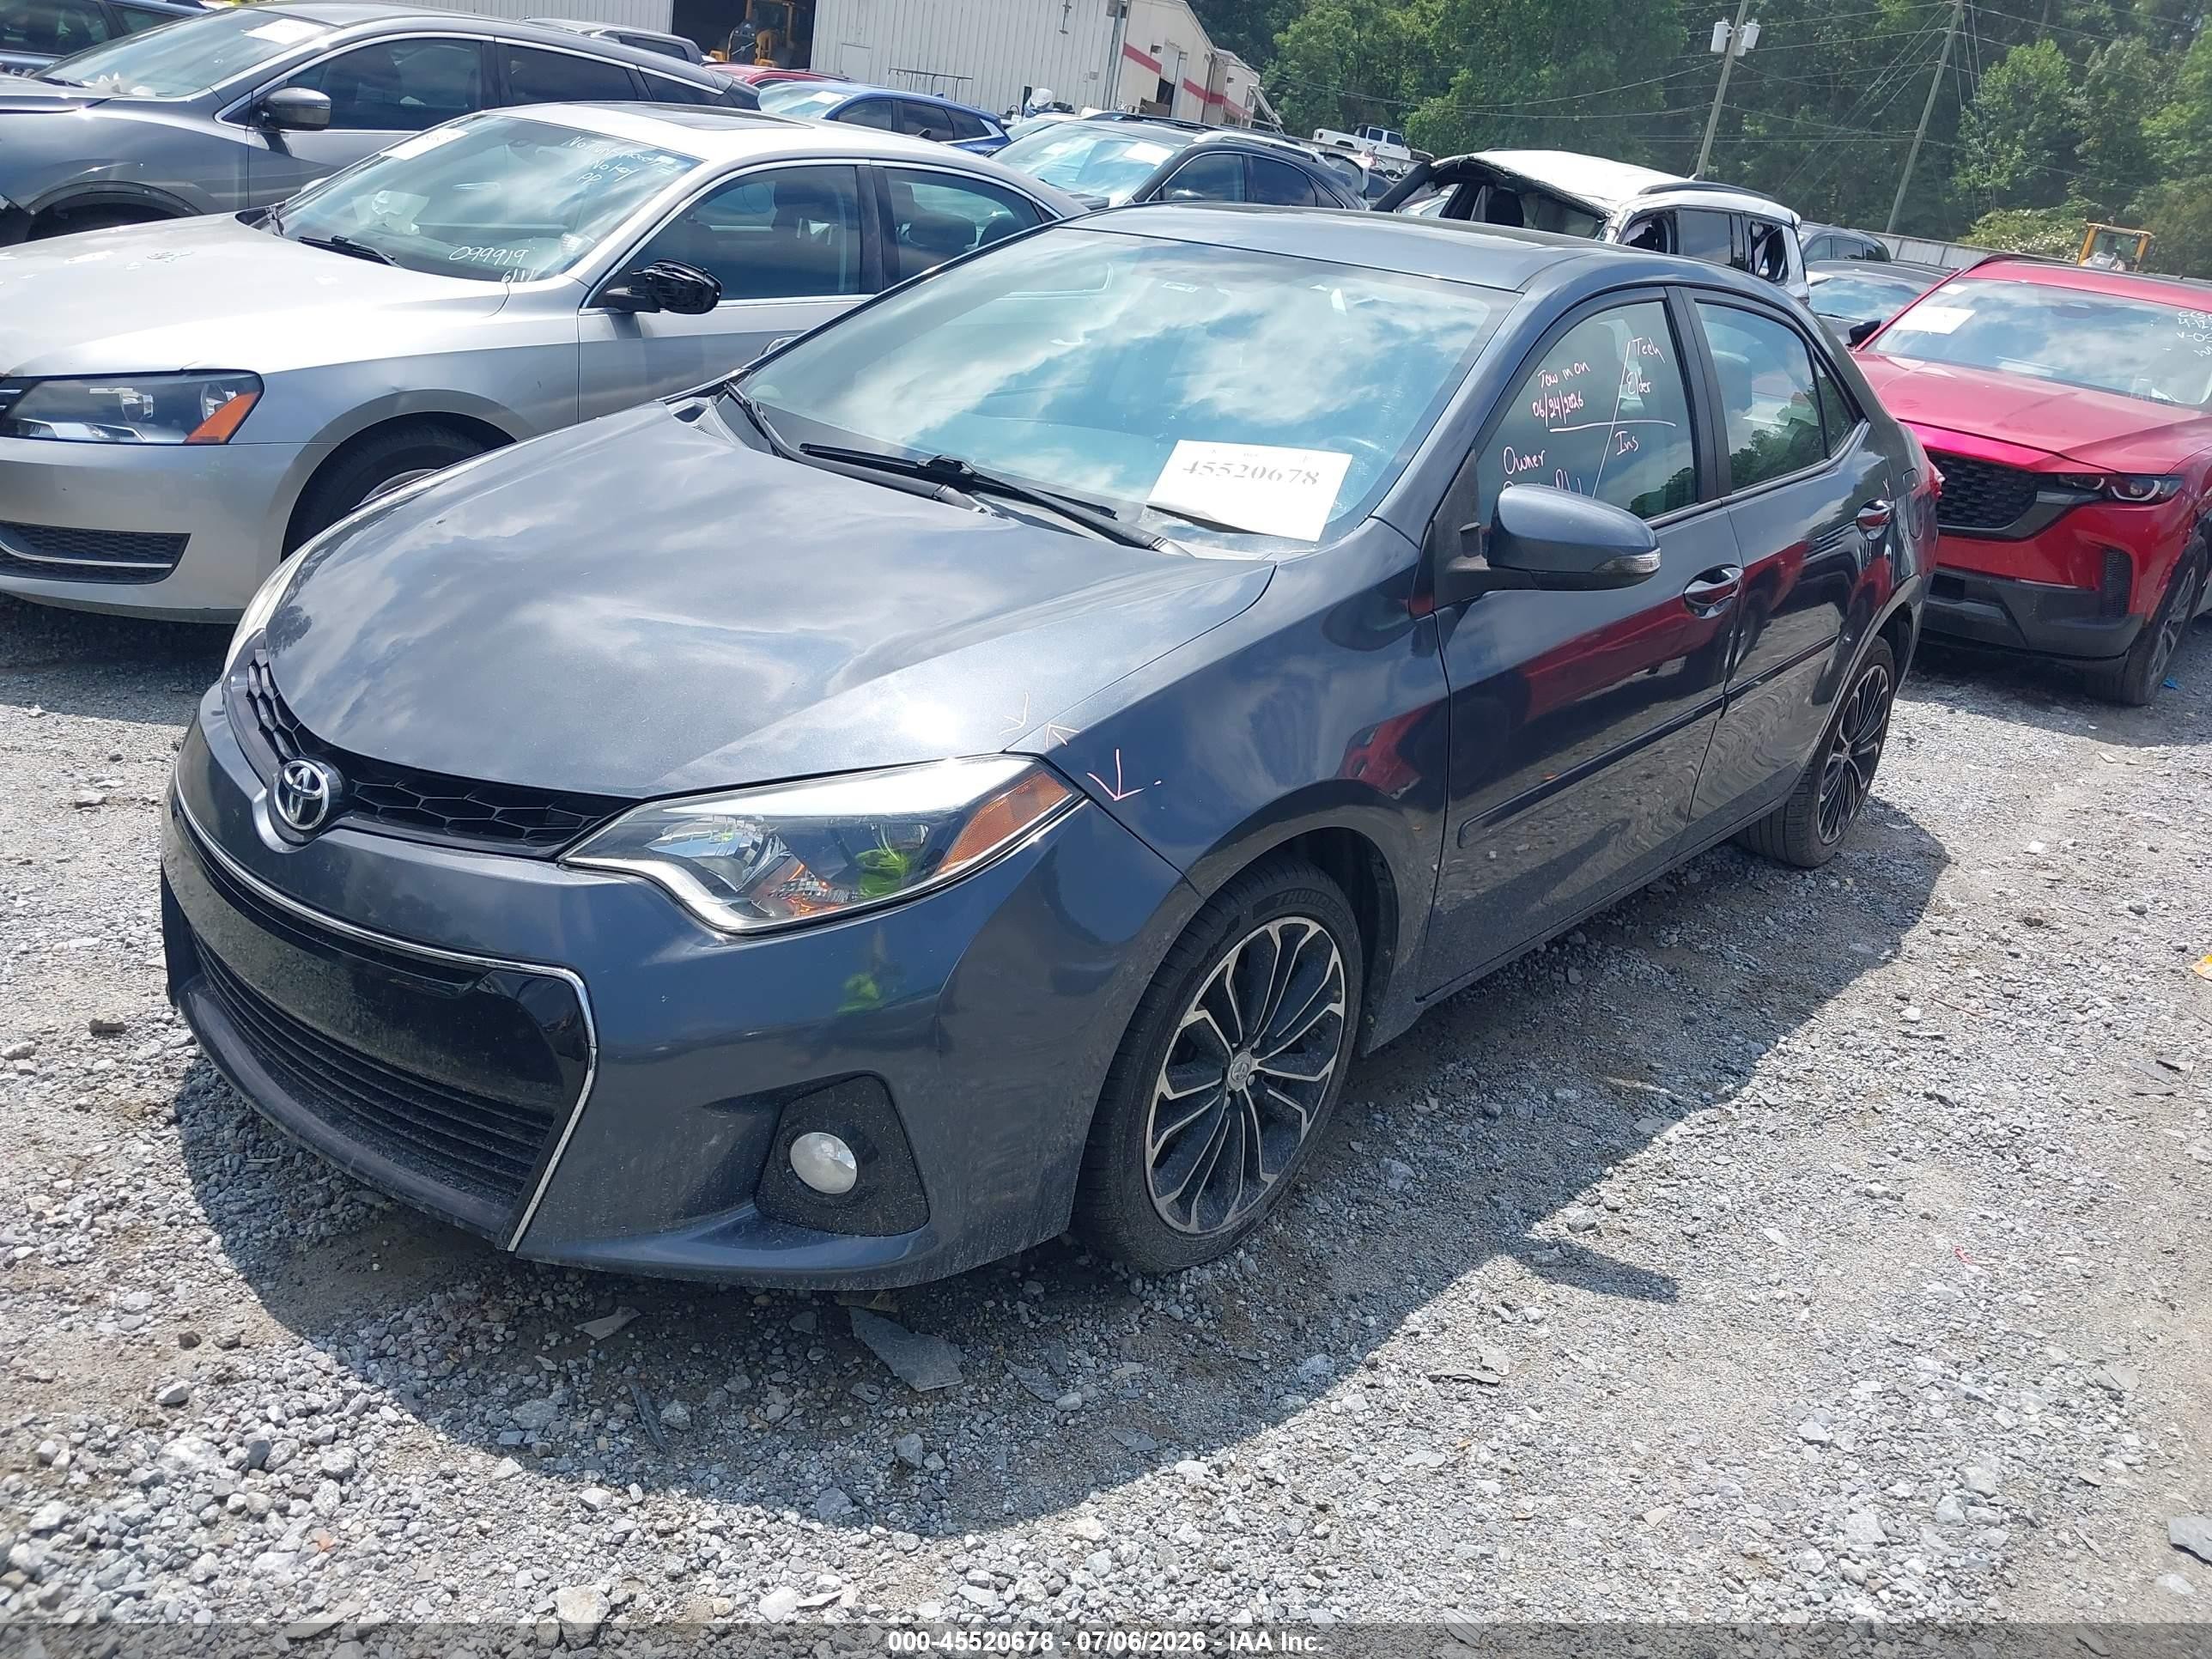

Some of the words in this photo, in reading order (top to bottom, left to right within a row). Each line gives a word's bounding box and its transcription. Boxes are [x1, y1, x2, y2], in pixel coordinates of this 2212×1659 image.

[448, 246, 530, 266] 099919
[1532, 390, 1584, 428] 06/24/2026
[1614, 430, 1639, 456] Ins
[1182, 459, 1320, 486] 45520678
[1503, 446, 1547, 476] Owner
